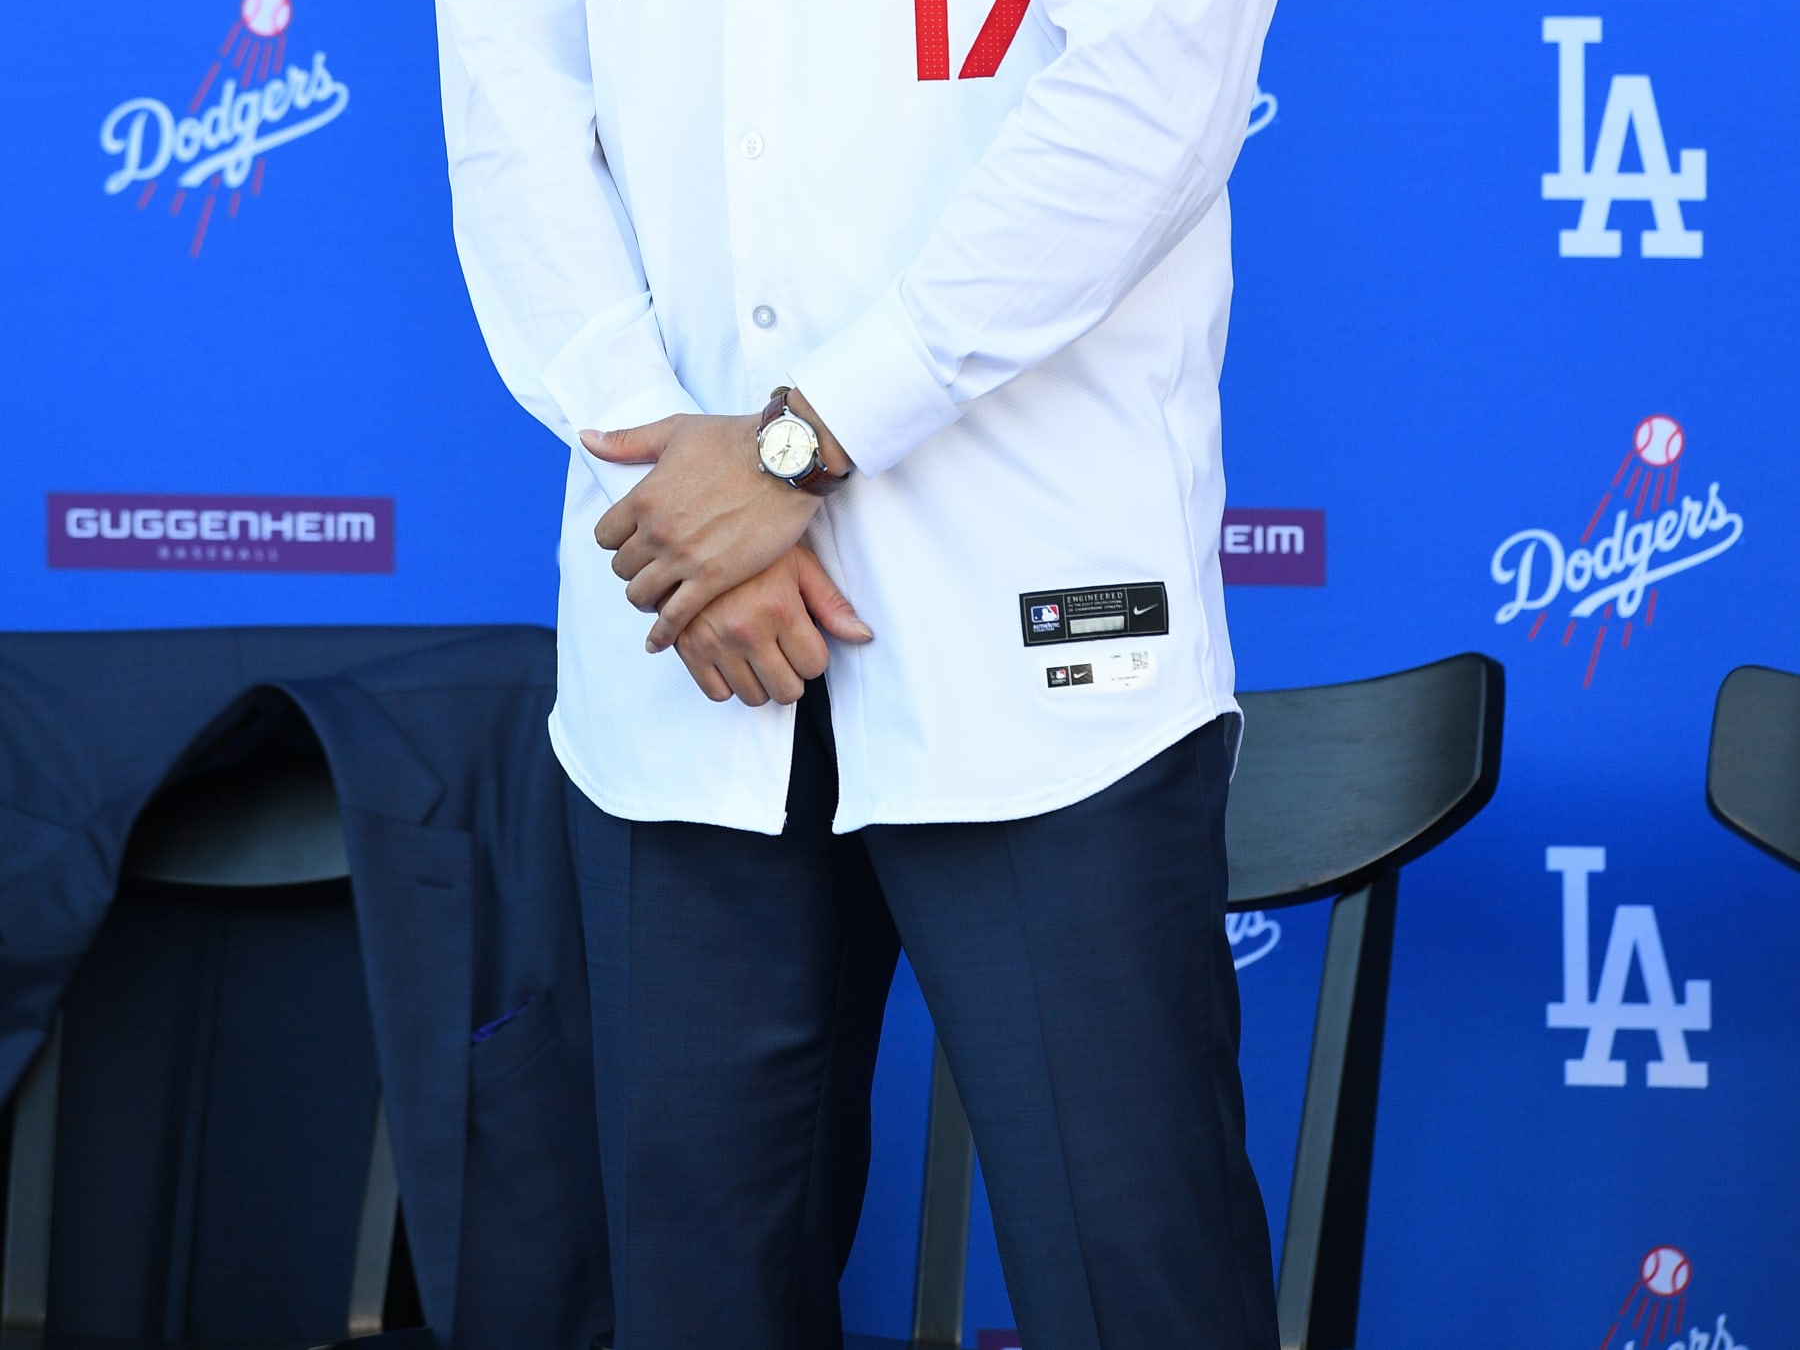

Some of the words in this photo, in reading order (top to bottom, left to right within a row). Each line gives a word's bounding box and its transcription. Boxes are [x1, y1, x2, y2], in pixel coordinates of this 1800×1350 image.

[101, 52, 349, 195] Dodgers
[1542, 17, 1706, 259] LA
[66, 508, 375, 542] GUGGENHEIM
[1491, 482, 1743, 624] Dodgers
[1067, 591, 1123, 604] ENGINEERED
[1546, 846, 1711, 1088] LA
